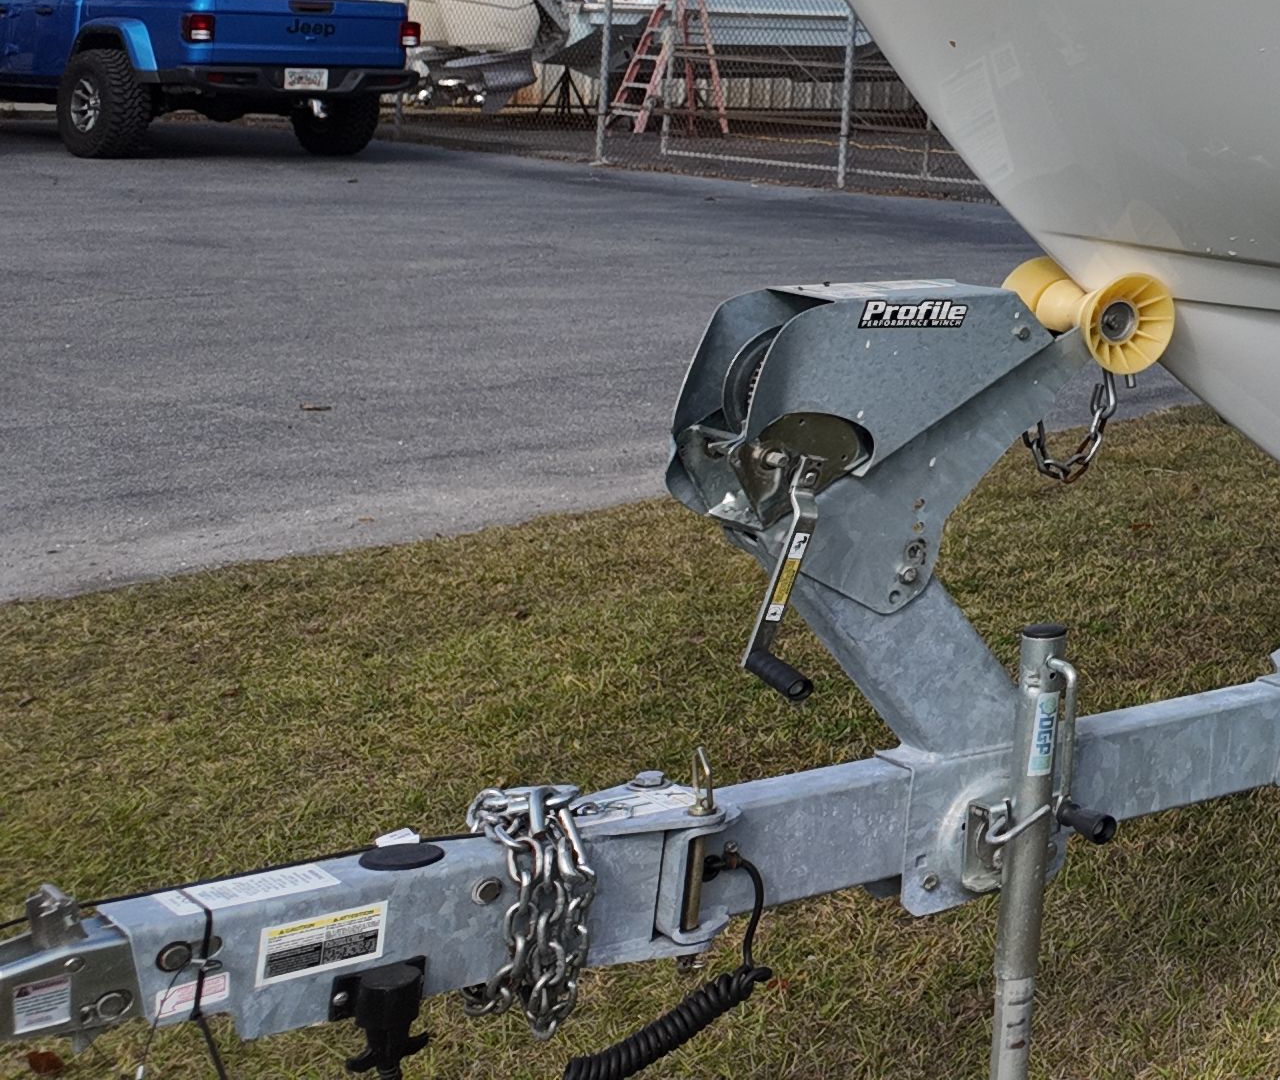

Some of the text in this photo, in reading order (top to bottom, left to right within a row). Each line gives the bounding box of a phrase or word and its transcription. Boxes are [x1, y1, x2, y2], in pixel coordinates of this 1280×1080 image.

[286, 18, 336, 37] Jeep
[861, 300, 968, 321] Profile
[860, 319, 962, 327] PERFORMANCE WINCH
